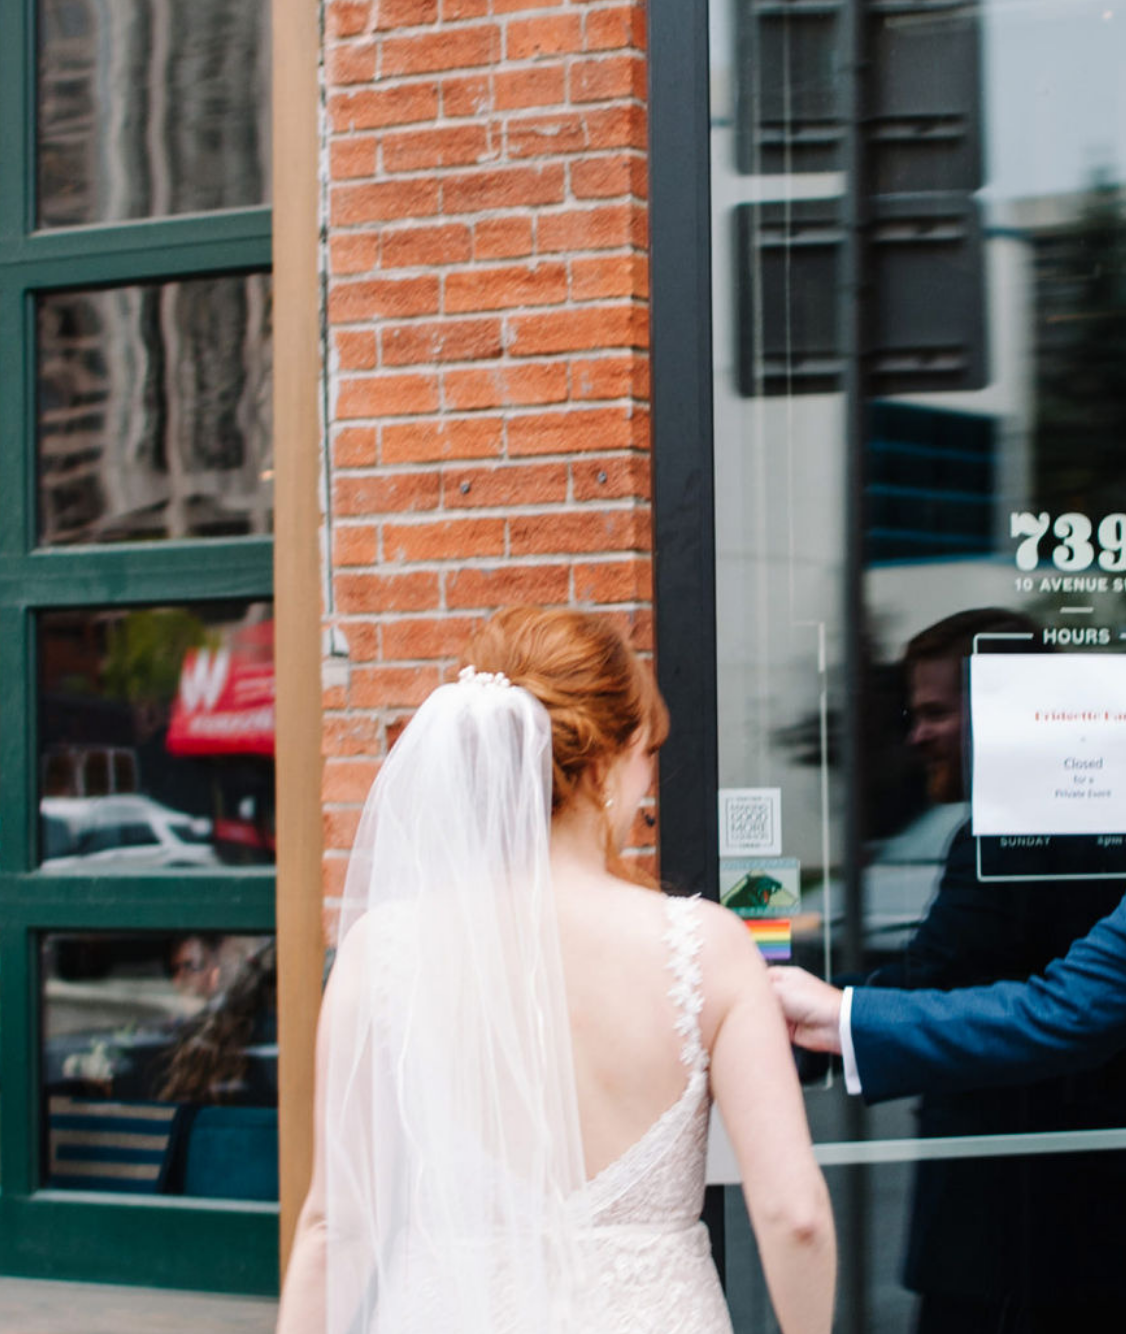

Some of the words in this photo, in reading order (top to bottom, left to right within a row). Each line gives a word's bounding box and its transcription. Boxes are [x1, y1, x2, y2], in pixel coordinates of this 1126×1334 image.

[1015, 577, 1034, 593] 10
[1040, 577, 1109, 593] AVENUE
[1042, 628, 1111, 645] HOURS
[1063, 756, 1104, 770] Closed
[1000, 836, 1051, 847] SUNDAY
